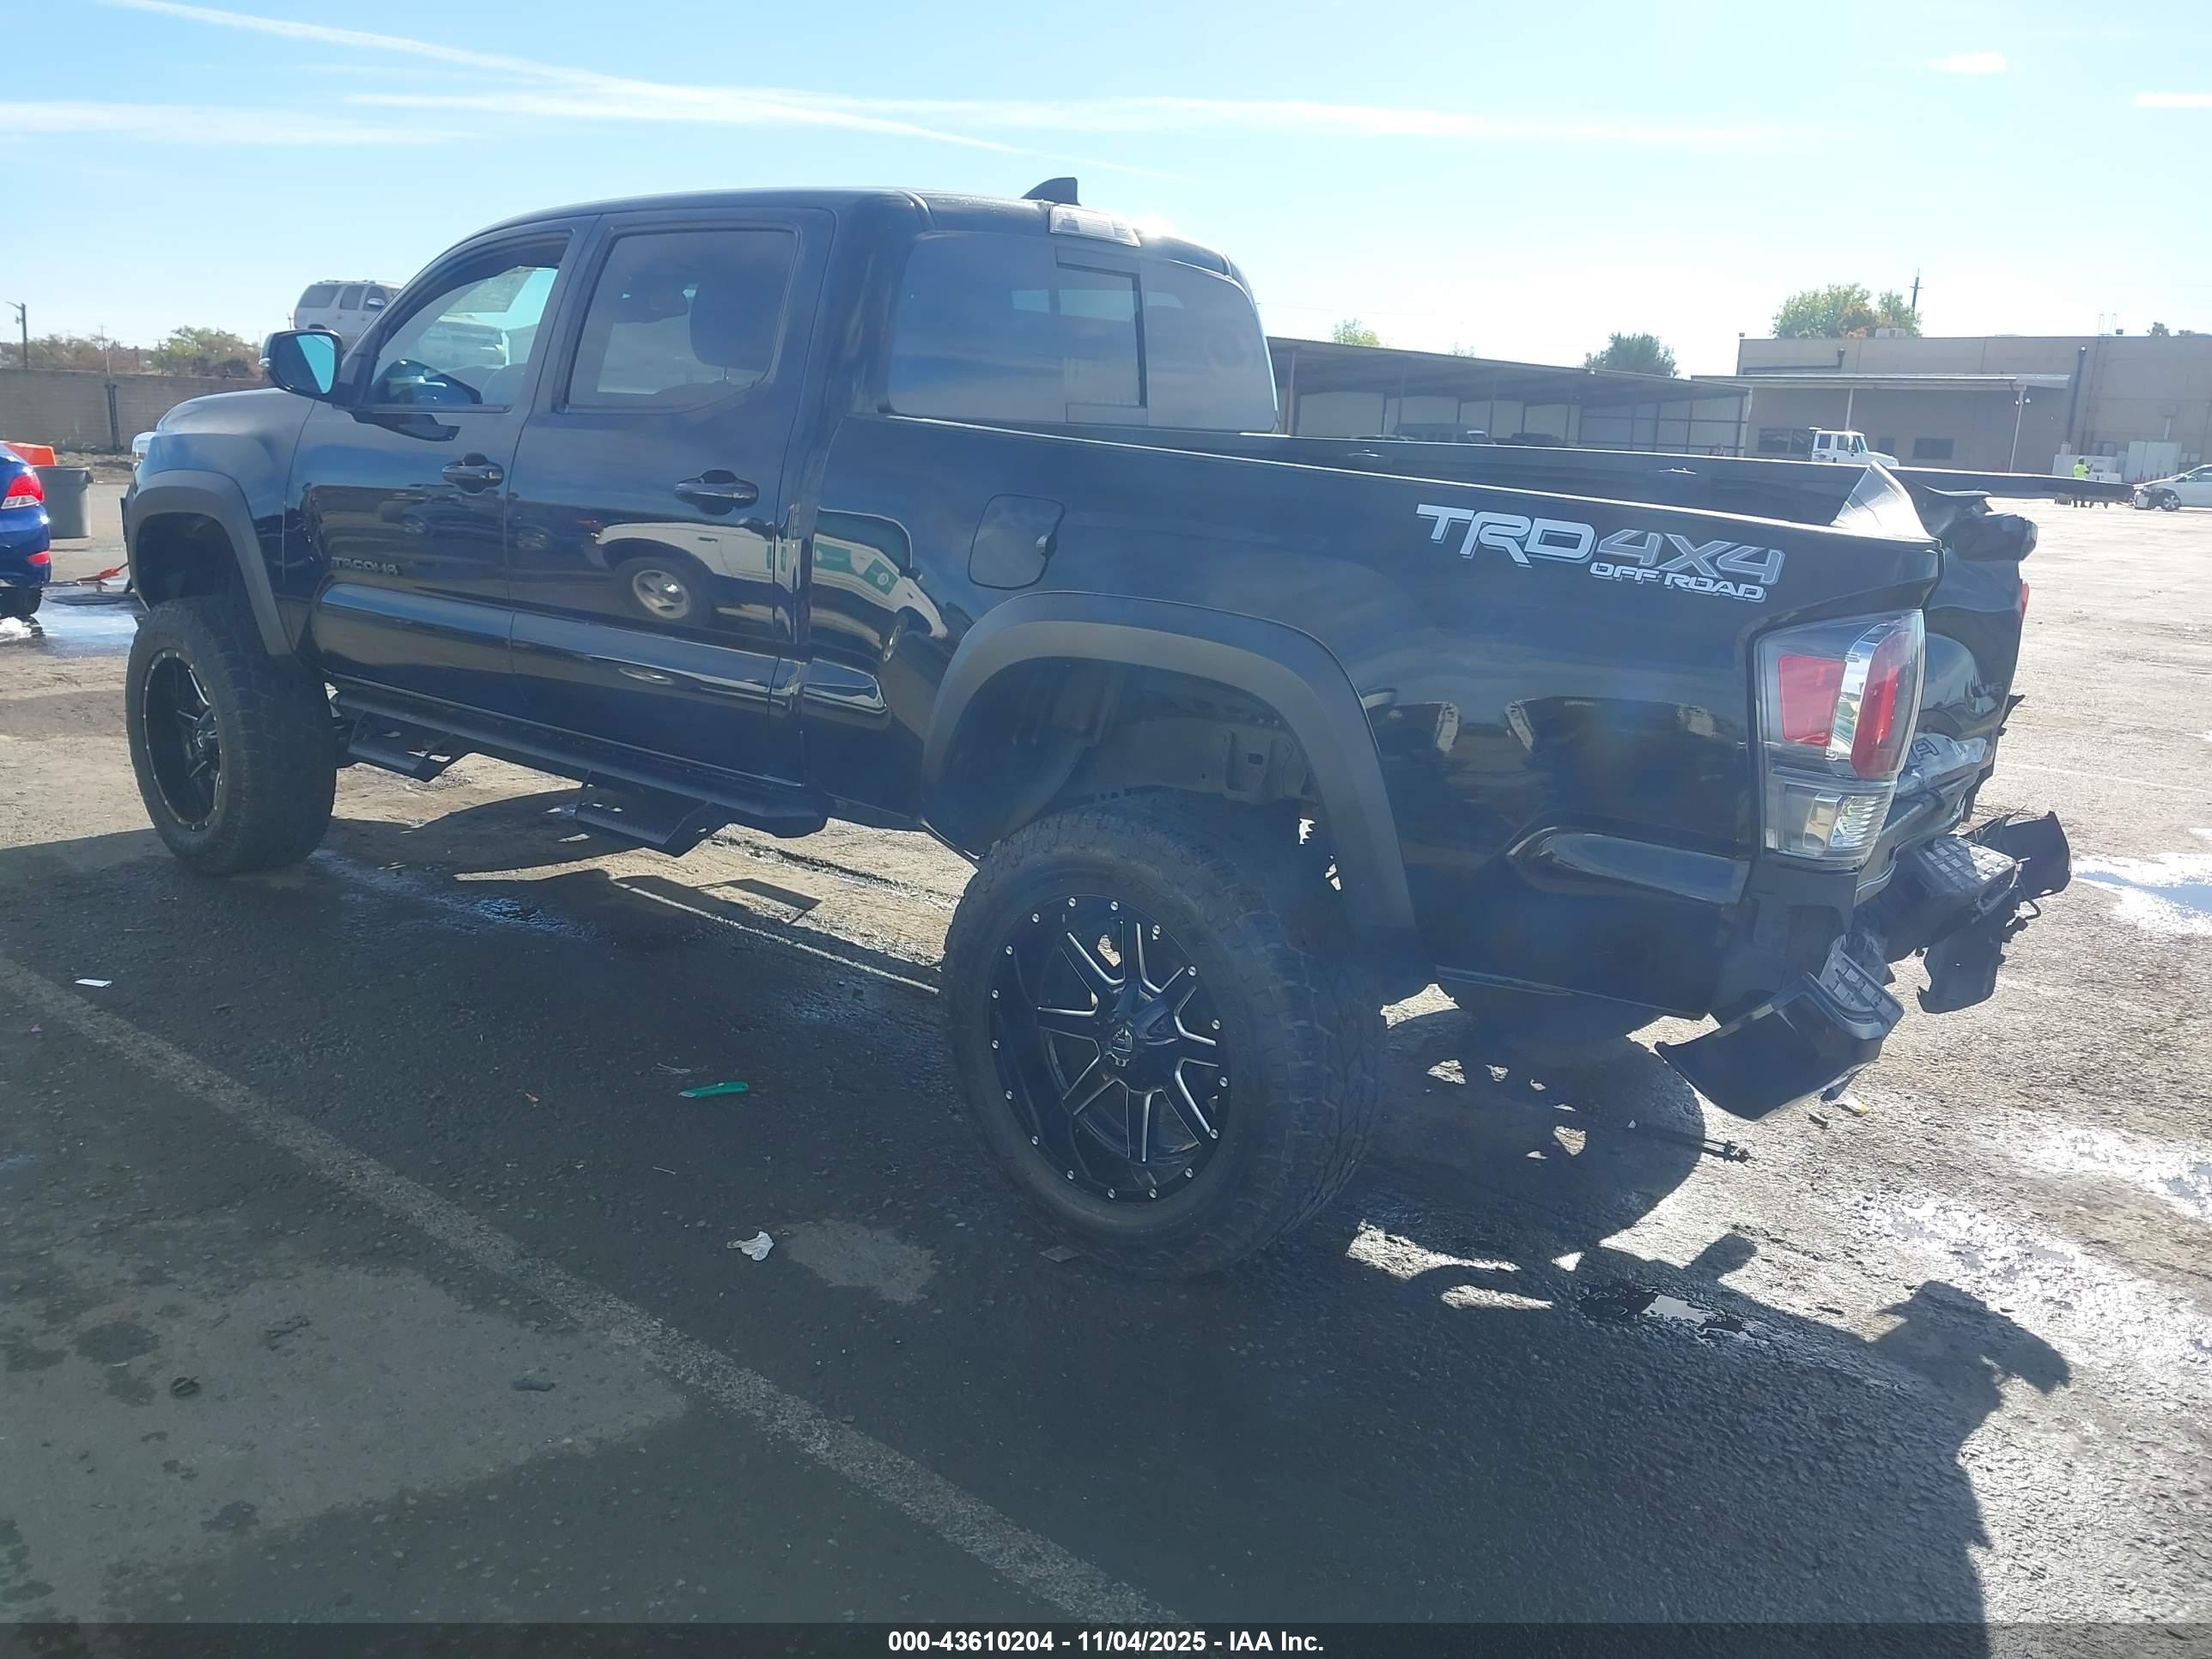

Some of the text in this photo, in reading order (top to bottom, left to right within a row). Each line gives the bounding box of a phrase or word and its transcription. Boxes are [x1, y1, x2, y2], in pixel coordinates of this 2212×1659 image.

[1416, 503, 1786, 585] TRD 4X4
[1589, 562, 1767, 602] OFF ROAD
